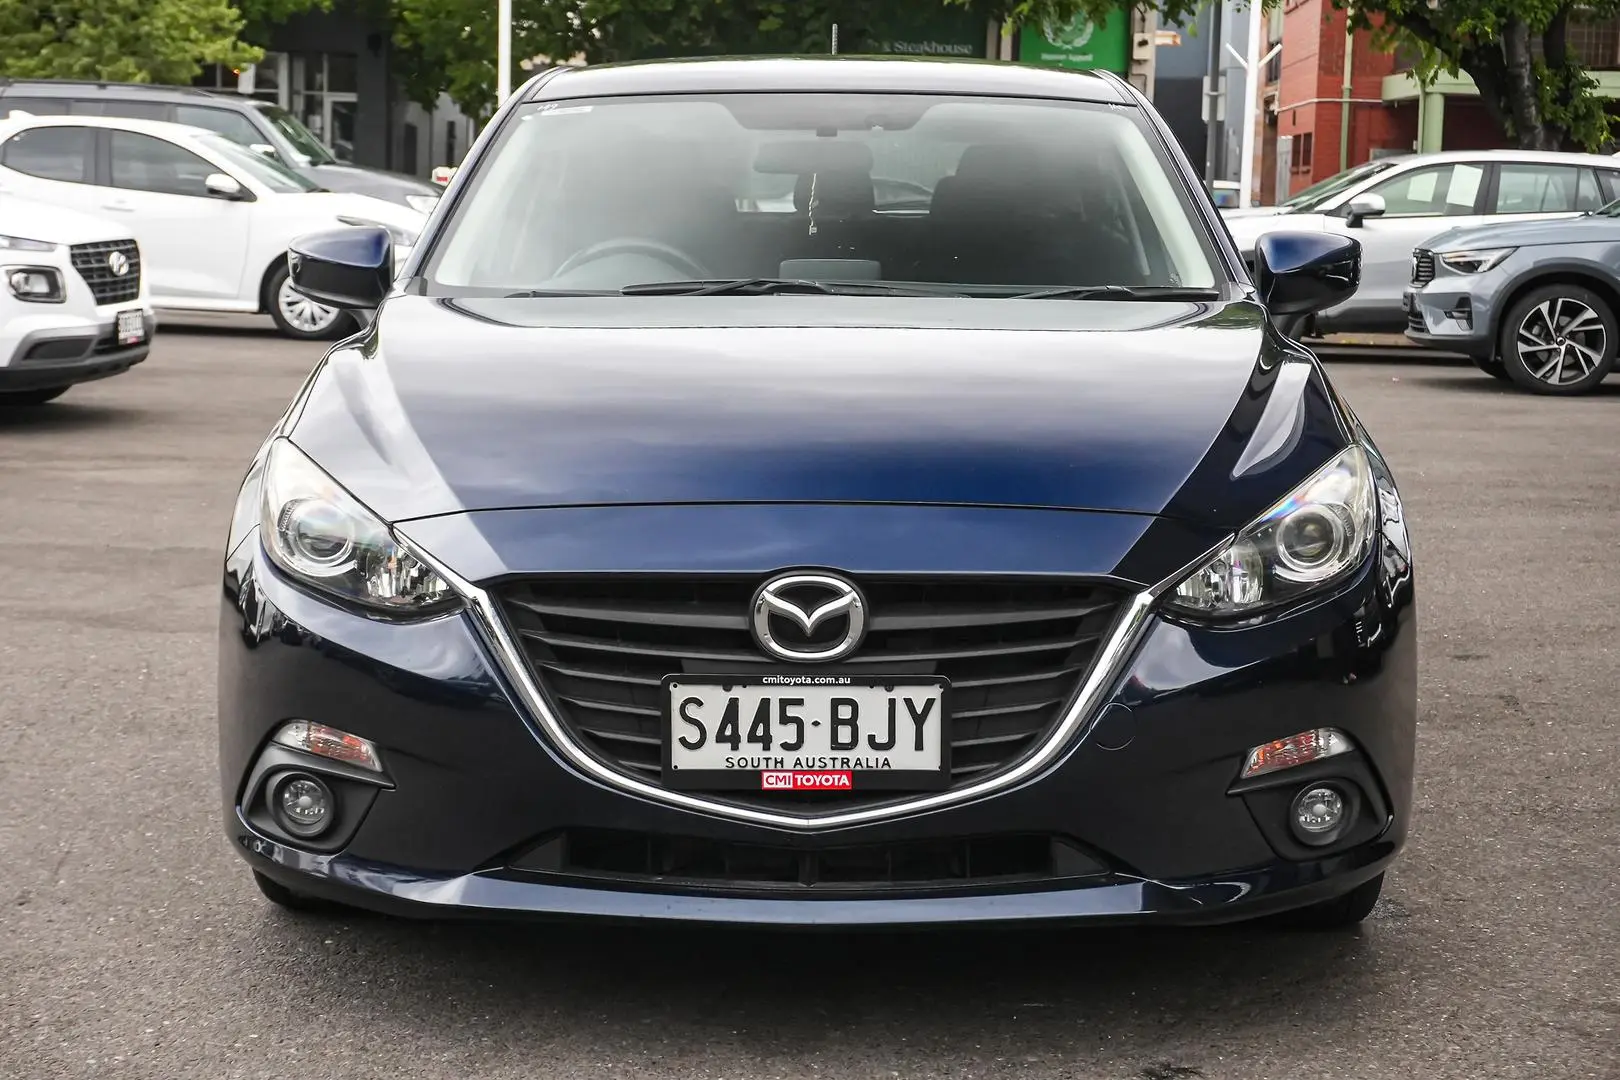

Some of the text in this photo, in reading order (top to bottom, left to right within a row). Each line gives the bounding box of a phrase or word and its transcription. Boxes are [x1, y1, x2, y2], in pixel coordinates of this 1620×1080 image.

[893, 40, 973, 54] Steakhouse
[762, 675, 851, 685] cmitoyota.com.au
[725, 756, 892, 769] SOUTH AUSTRALIA
[765, 774, 850, 786] CMI TOYOTA
